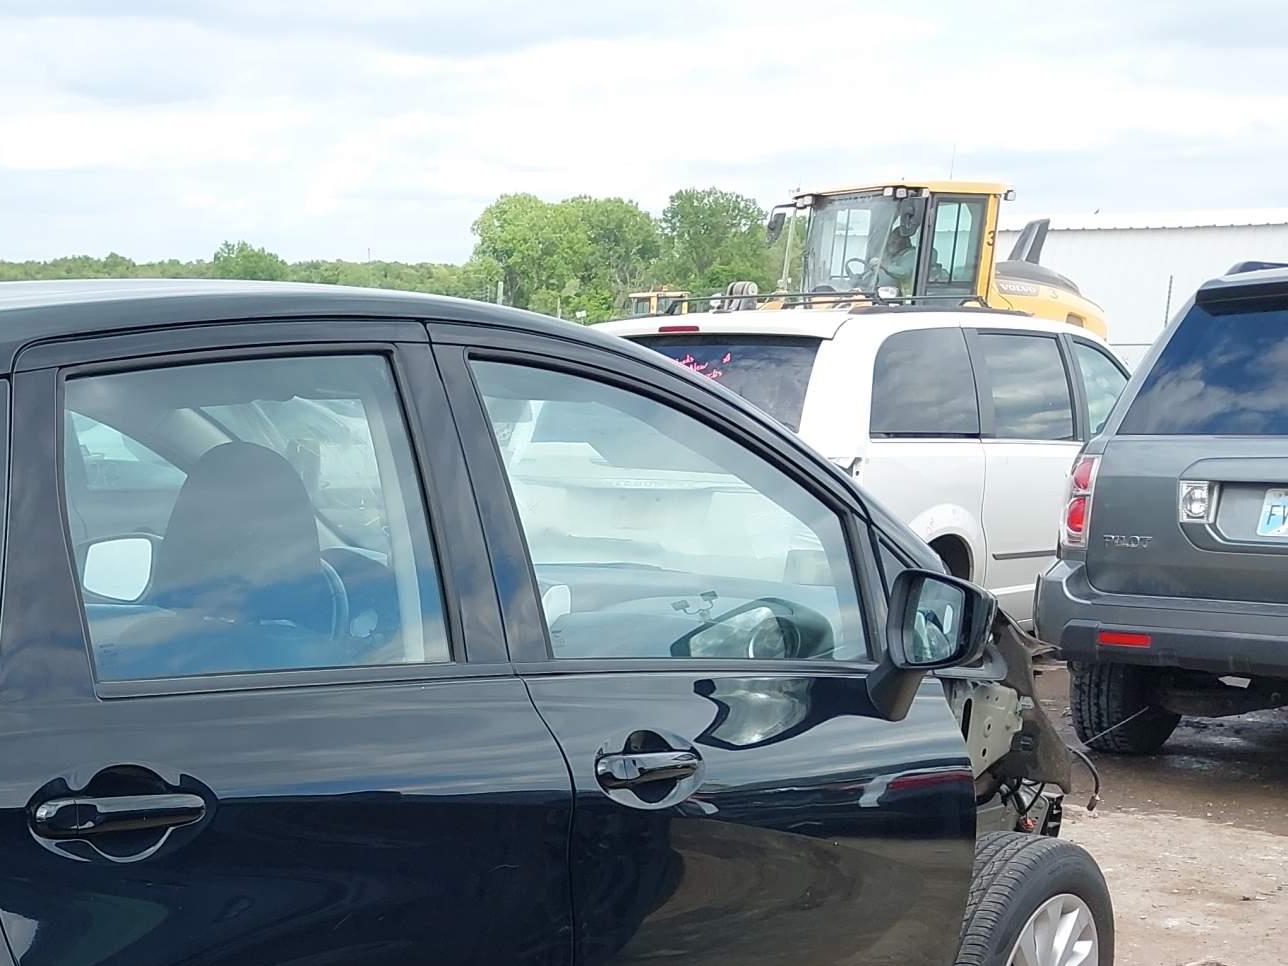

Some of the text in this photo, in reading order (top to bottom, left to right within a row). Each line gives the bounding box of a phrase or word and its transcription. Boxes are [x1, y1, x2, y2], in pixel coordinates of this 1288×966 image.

[987, 230, 994, 246] 3
[999, 282, 1038, 294] VOLVO
[1103, 534, 1153, 549] PILOT
